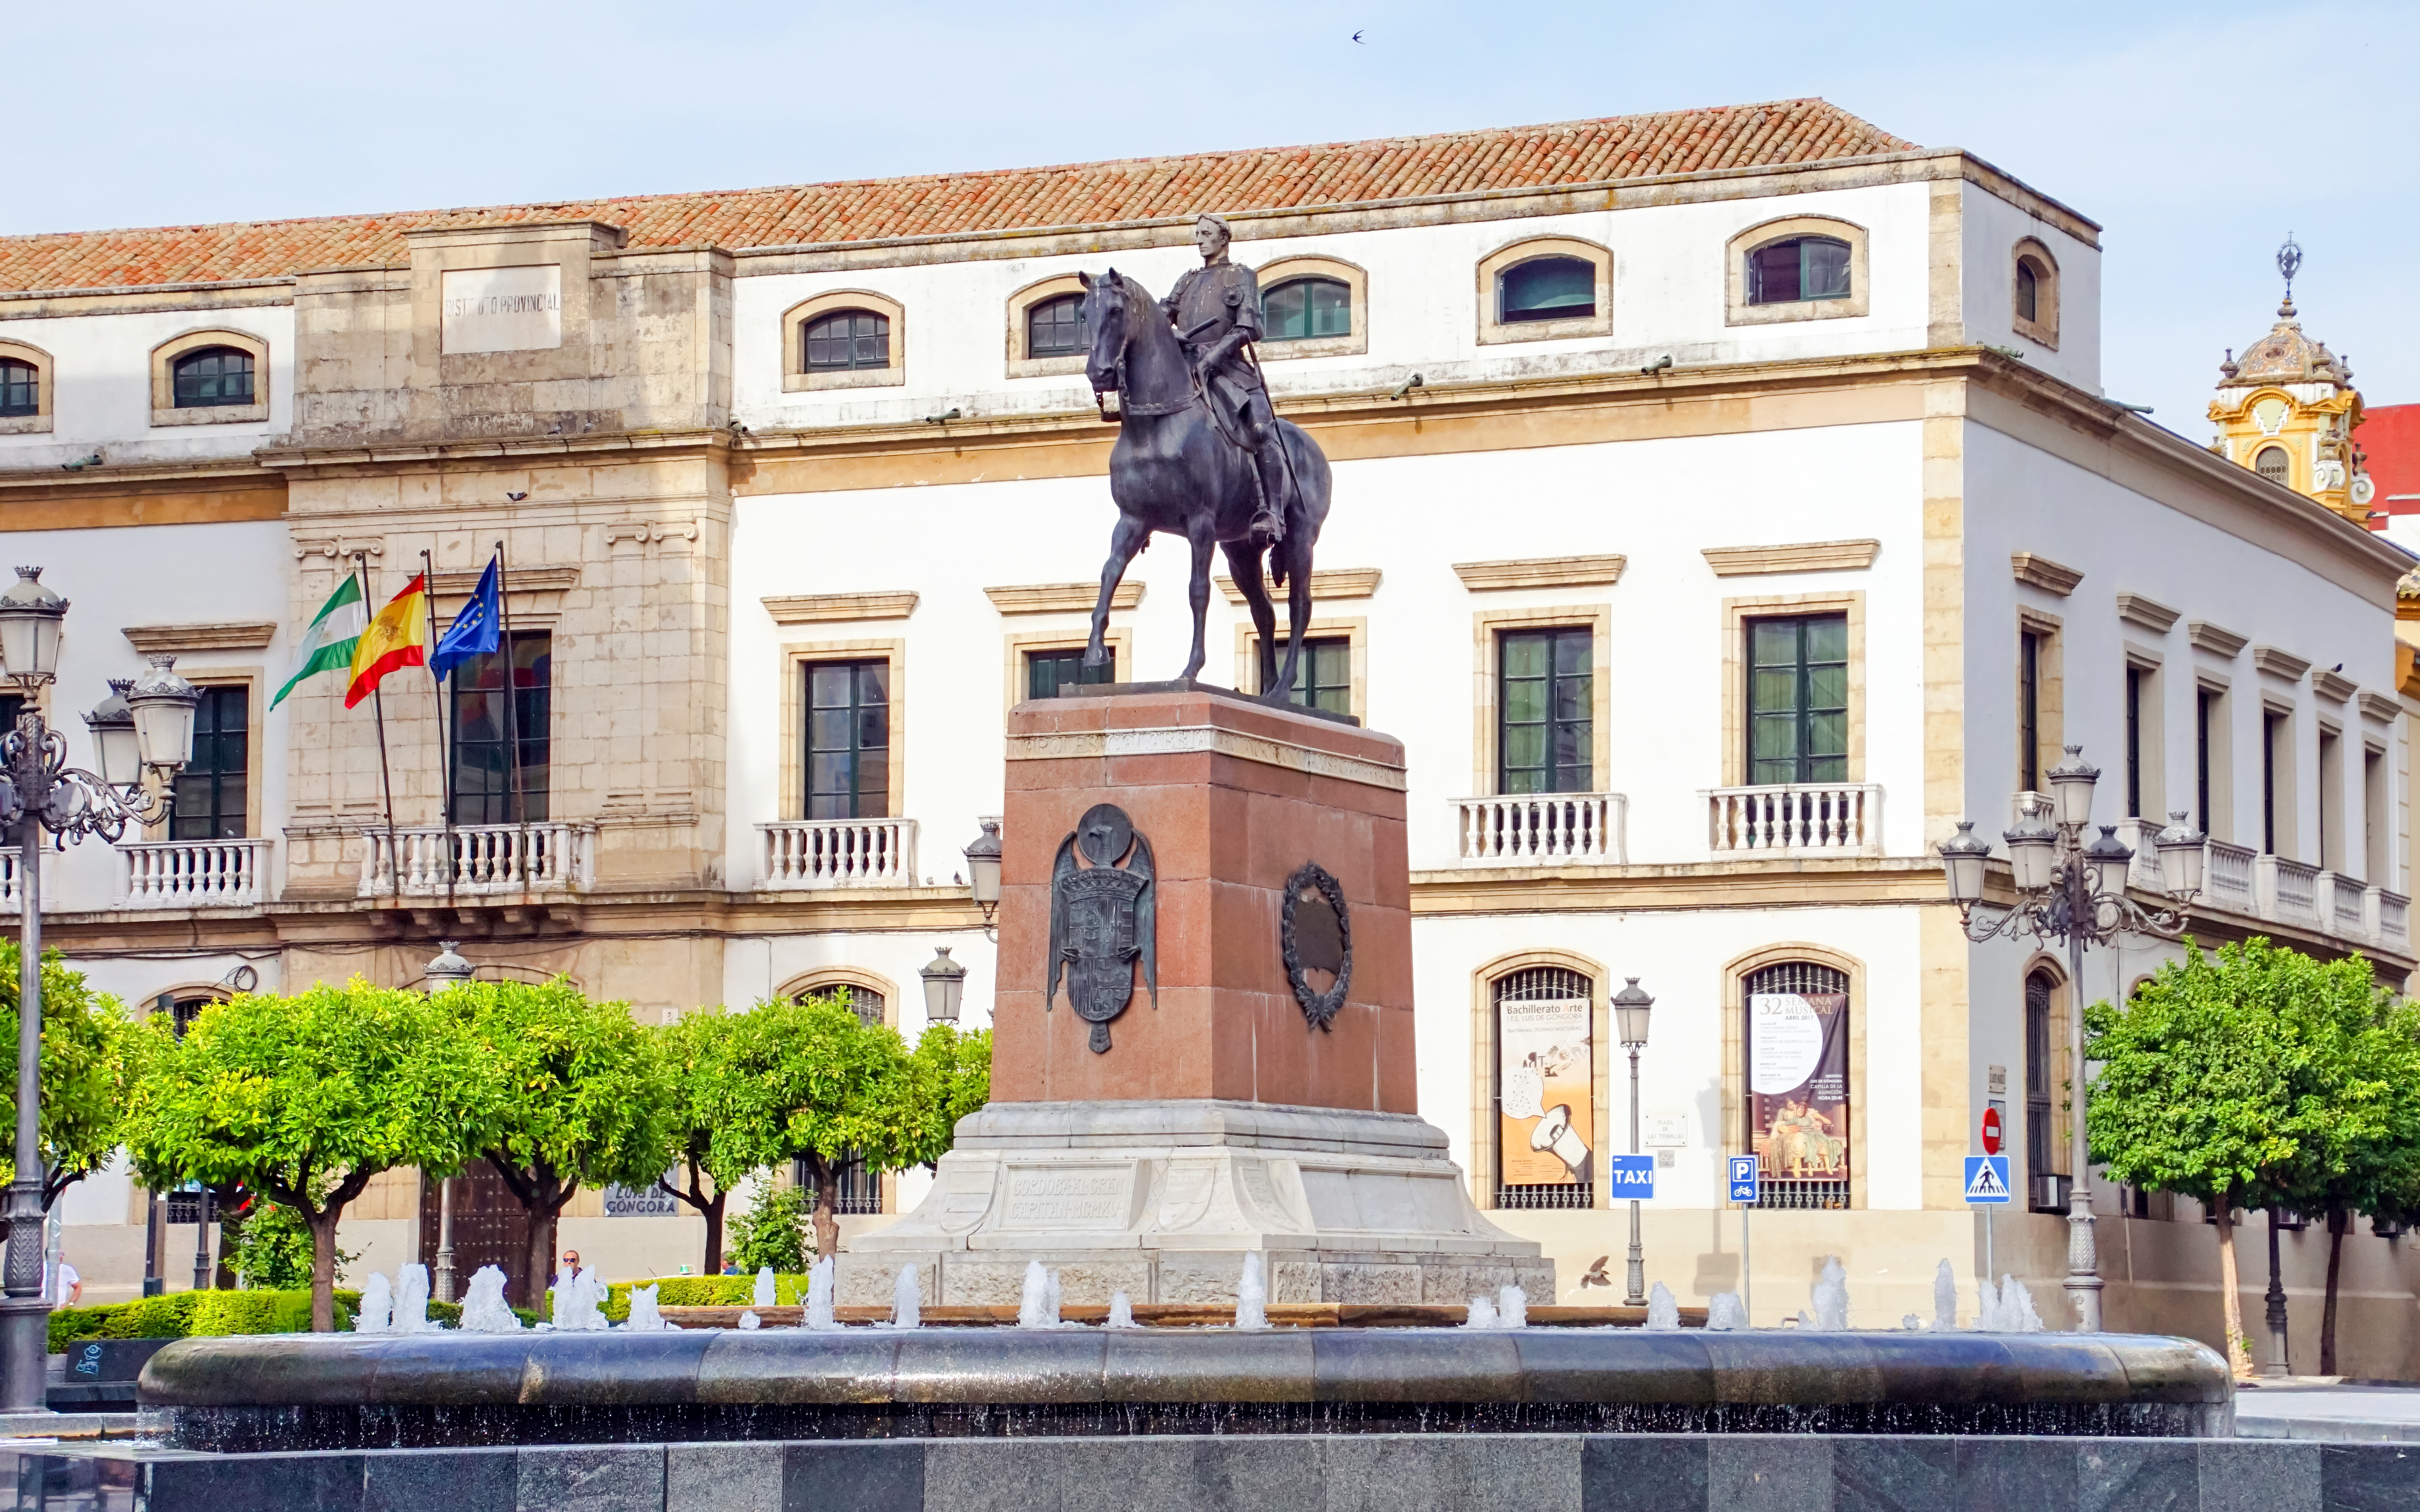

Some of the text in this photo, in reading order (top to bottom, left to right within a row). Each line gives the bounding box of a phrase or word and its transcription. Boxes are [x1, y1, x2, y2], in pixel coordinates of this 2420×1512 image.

[500, 293, 559, 313] PROVINCIAL
[1507, 1004, 1582, 1014] Bachillerato Arte
[1760, 997, 1832, 1015] 32 SEMANA
[1785, 1006, 1833, 1014] MUSICAL
[1614, 1170, 1652, 1184] TAXI
[1736, 1163, 1749, 1179] P
[616, 1187, 666, 1198] LUS DE
[1014, 1178, 1071, 1196] CORDOBA
[1089, 1177, 1125, 1195] GRAN
[607, 1199, 675, 1212] GÓNGORA
[1011, 1202, 1069, 1219] CAPITAN
